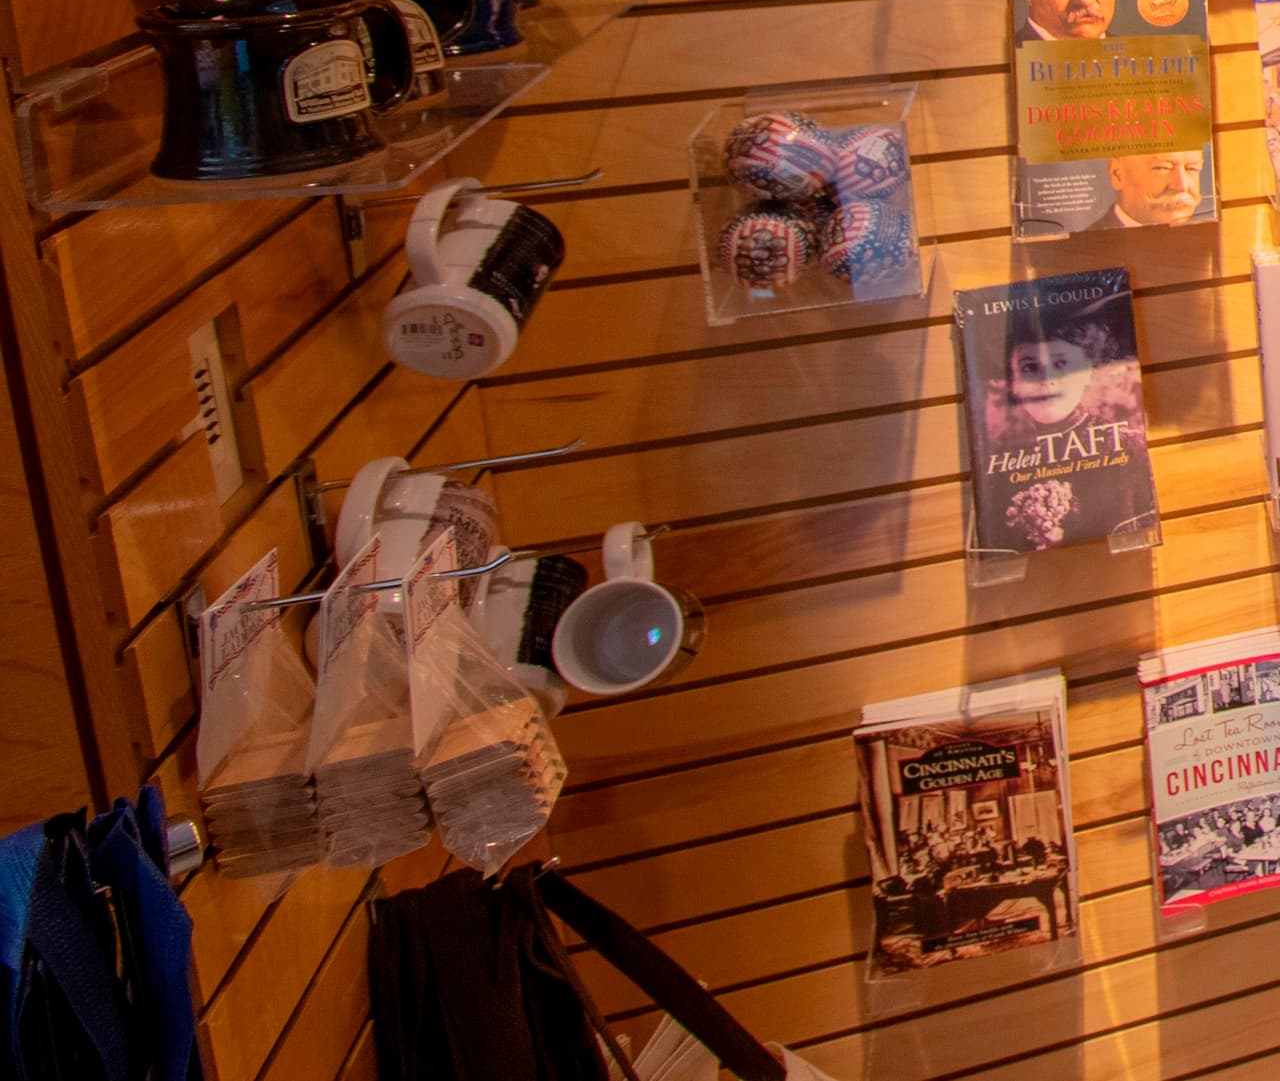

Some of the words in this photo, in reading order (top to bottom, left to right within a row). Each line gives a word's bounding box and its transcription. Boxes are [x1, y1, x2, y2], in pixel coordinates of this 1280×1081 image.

[1037, 421, 1128, 463] TAFT
[988, 447, 1041, 475] Helen
[1010, 472, 1036, 483] Our
[1036, 462, 1073, 478] Musical
[1075, 458, 1100, 471] First
[1104, 453, 1129, 466] Lady
[1175, 728, 1214, 751] Lost
[1216, 719, 1241, 738] Tea
[903, 749, 1015, 779] CINCINNATI'S
[920, 774, 972, 791] GOLDEN
[975, 769, 1003, 782] AGE
